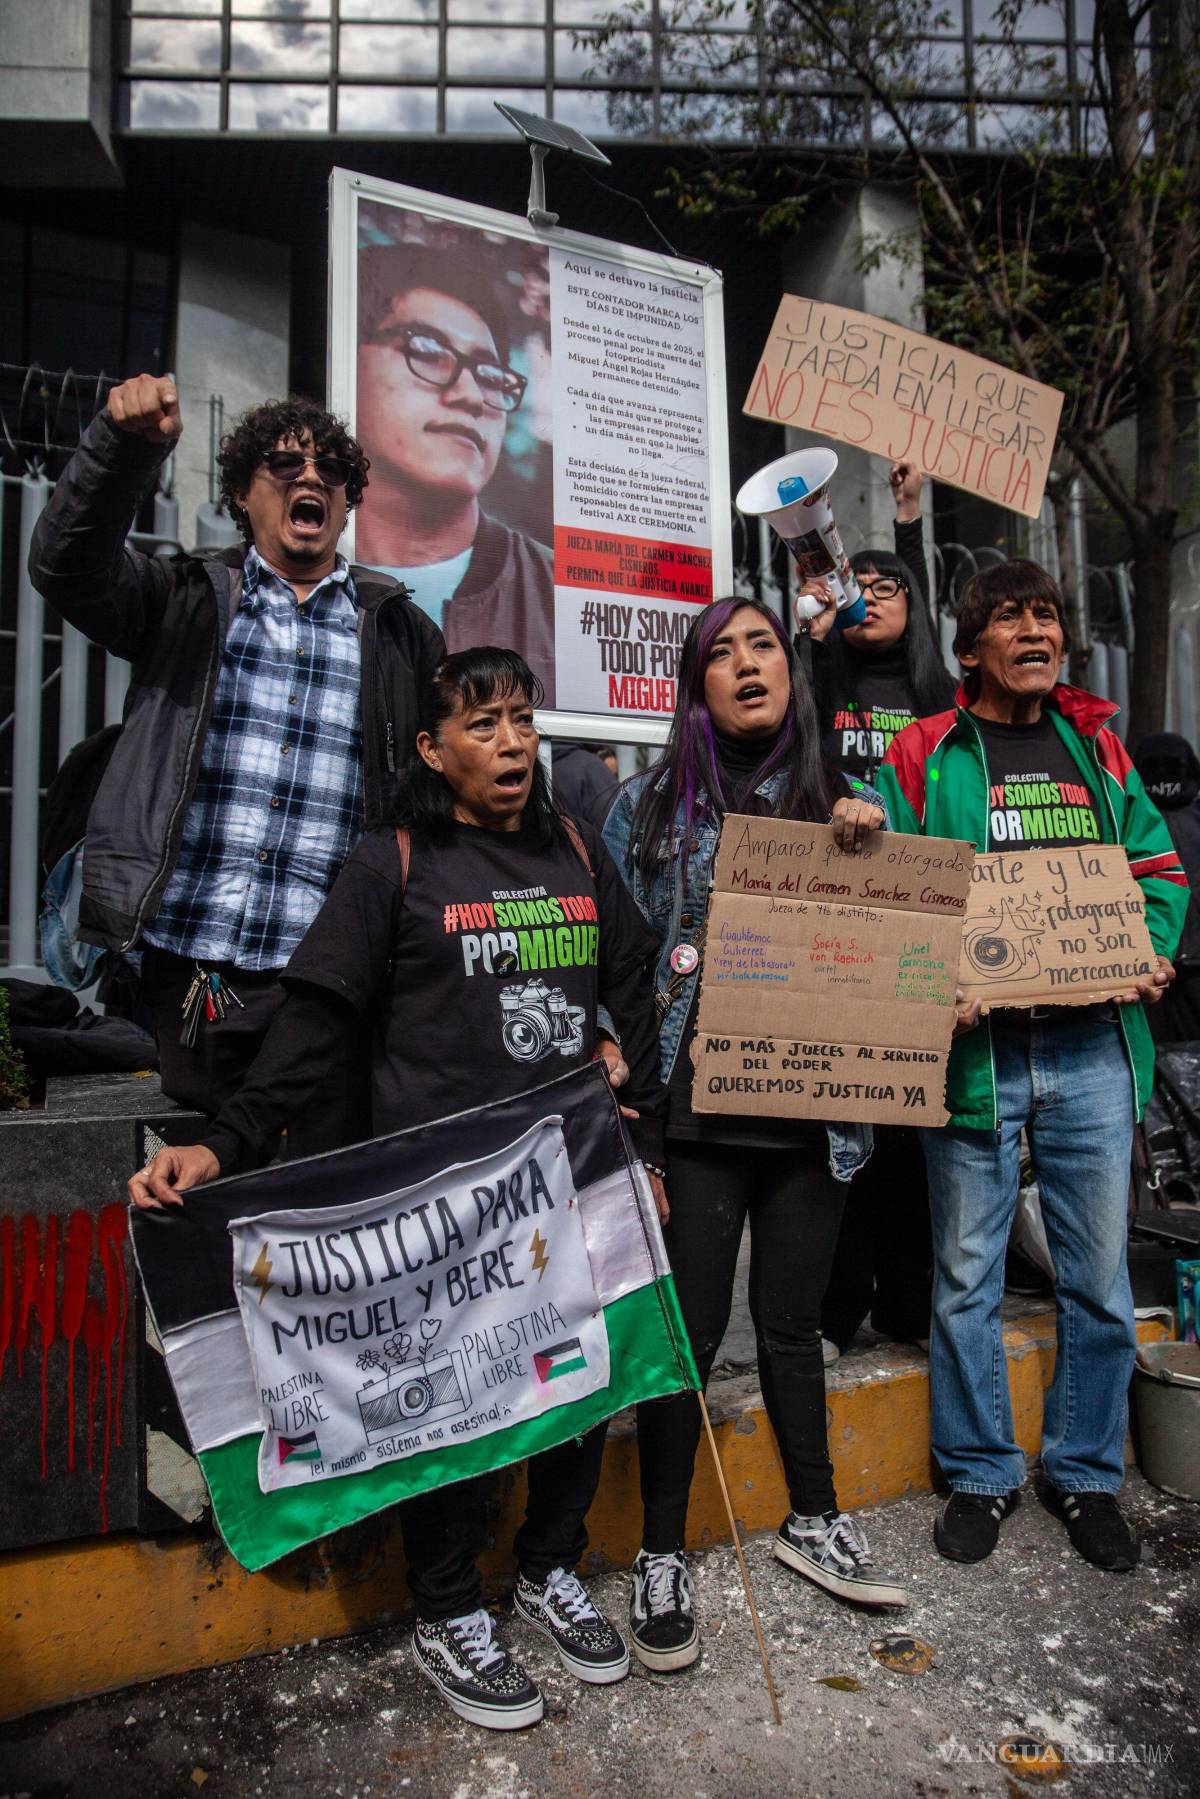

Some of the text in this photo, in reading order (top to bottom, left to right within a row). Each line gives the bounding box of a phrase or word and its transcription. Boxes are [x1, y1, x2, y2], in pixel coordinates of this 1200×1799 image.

[565, 261, 700, 304] Aquí se detuvo la justicia.
[568, 285, 699, 325] ESTE CONTADOR MARCA LOS
[586, 299, 610, 313] DÍAS
[612, 307, 624, 316] DE
[563, 317, 695, 357] Desde 16 octubre de 2025,
[567, 330, 702, 368] proceso penal por muerte del
[568, 352, 700, 390] Miguel Ángel Rojas Hernández
[605, 349, 666, 370] fotoperiodista
[776, 336, 882, 395] TARDA
[893, 372, 935, 415] EN
[786, 299, 1039, 421] JUSTICIA QUE
[592, 369, 681, 397] permanece detenido.
[567, 386, 705, 424] Cada día que avanza representa:
[586, 403, 696, 434] un día más que protege
[585, 427, 598, 435] un
[600, 428, 614, 438] día
[616, 432, 633, 442] más
[649, 439, 664, 449] que
[676, 443, 705, 457] justicia
[590, 414, 700, 444] las empresas responsables
[749, 363, 1033, 511] NO ES JUSTICIA
[628, 447, 664, 460] no llega.
[566, 469, 698, 501] impide que se formulen cargos
[568, 456, 707, 491] Esta decisión de jueza federal,
[570, 495, 697, 522] responsables de muerte en
[573, 482, 704, 512] homicidio contra las empresas
[580, 507, 696, 534] festival AXE CEREMONIA.
[567, 535, 592, 551] JUEZA
[624, 543, 639, 558] DEL
[641, 546, 675, 564] CARMEN
[567, 566, 606, 584] PERMITA
[608, 571, 624, 587] QUE
[627, 573, 637, 587] LA
[640, 575, 677, 593] JUSTICIA
[580, 601, 633, 639] #HOY
[598, 638, 646, 676] TODO
[872, 705, 912, 716] COLECTIVA
[1005, 773, 1051, 783] COLECTIVA
[733, 822, 965, 876] Amparos otorgado
[731, 868, 966, 909] María del Carmen Sanchez Cisneros
[1047, 860, 1069, 895] y
[1077, 849, 1108, 879] la
[492, 886, 548, 900] COLECTIVA
[1058, 932, 1137, 955] no son
[1044, 958, 1153, 986] mercancía
[705, 1035, 939, 1064] NO MÁS JUECES AL SERVICIO
[742, 1058, 833, 1072] DEL PODER
[707, 1076, 926, 1108] QUEREMOS JUSTICIA YA
[278, 1158, 555, 1298] JUSTICIA PARA
[271, 1297, 408, 1355] MIGUEL
[446, 1239, 525, 1308] BERE
[461, 1301, 568, 1369] PALESTINA
[261, 1371, 324, 1404] PALESTINA
[482, 1355, 528, 1390] LIBRE
[270, 1389, 331, 1433] LIBRE
[331, 1450, 368, 1474] mismo
[376, 1429, 423, 1460] sistema
[427, 1427, 445, 1441] nos
